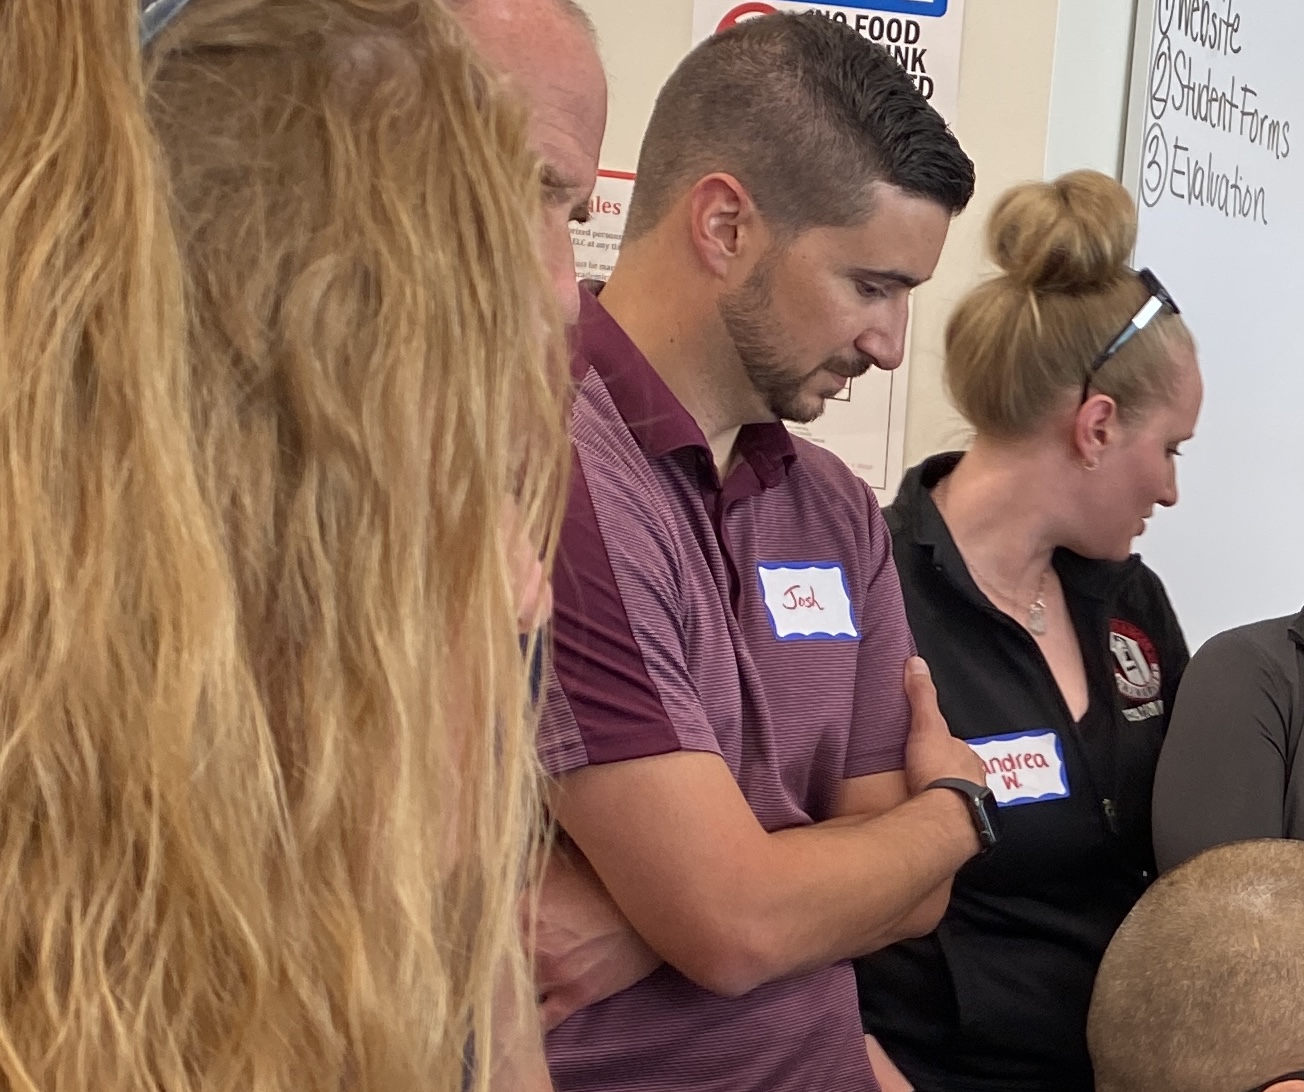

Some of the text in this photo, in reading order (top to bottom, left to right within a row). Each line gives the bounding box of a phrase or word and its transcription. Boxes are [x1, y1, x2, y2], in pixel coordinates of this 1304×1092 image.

[855, 14, 920, 45] FOOD
[1177, 0, 1242, 55] Website
[1171, 49, 1239, 133] Student
[1240, 84, 1290, 160] Forms
[1169, 135, 1268, 226] Evaluation
[782, 584, 825, 611] Josh
